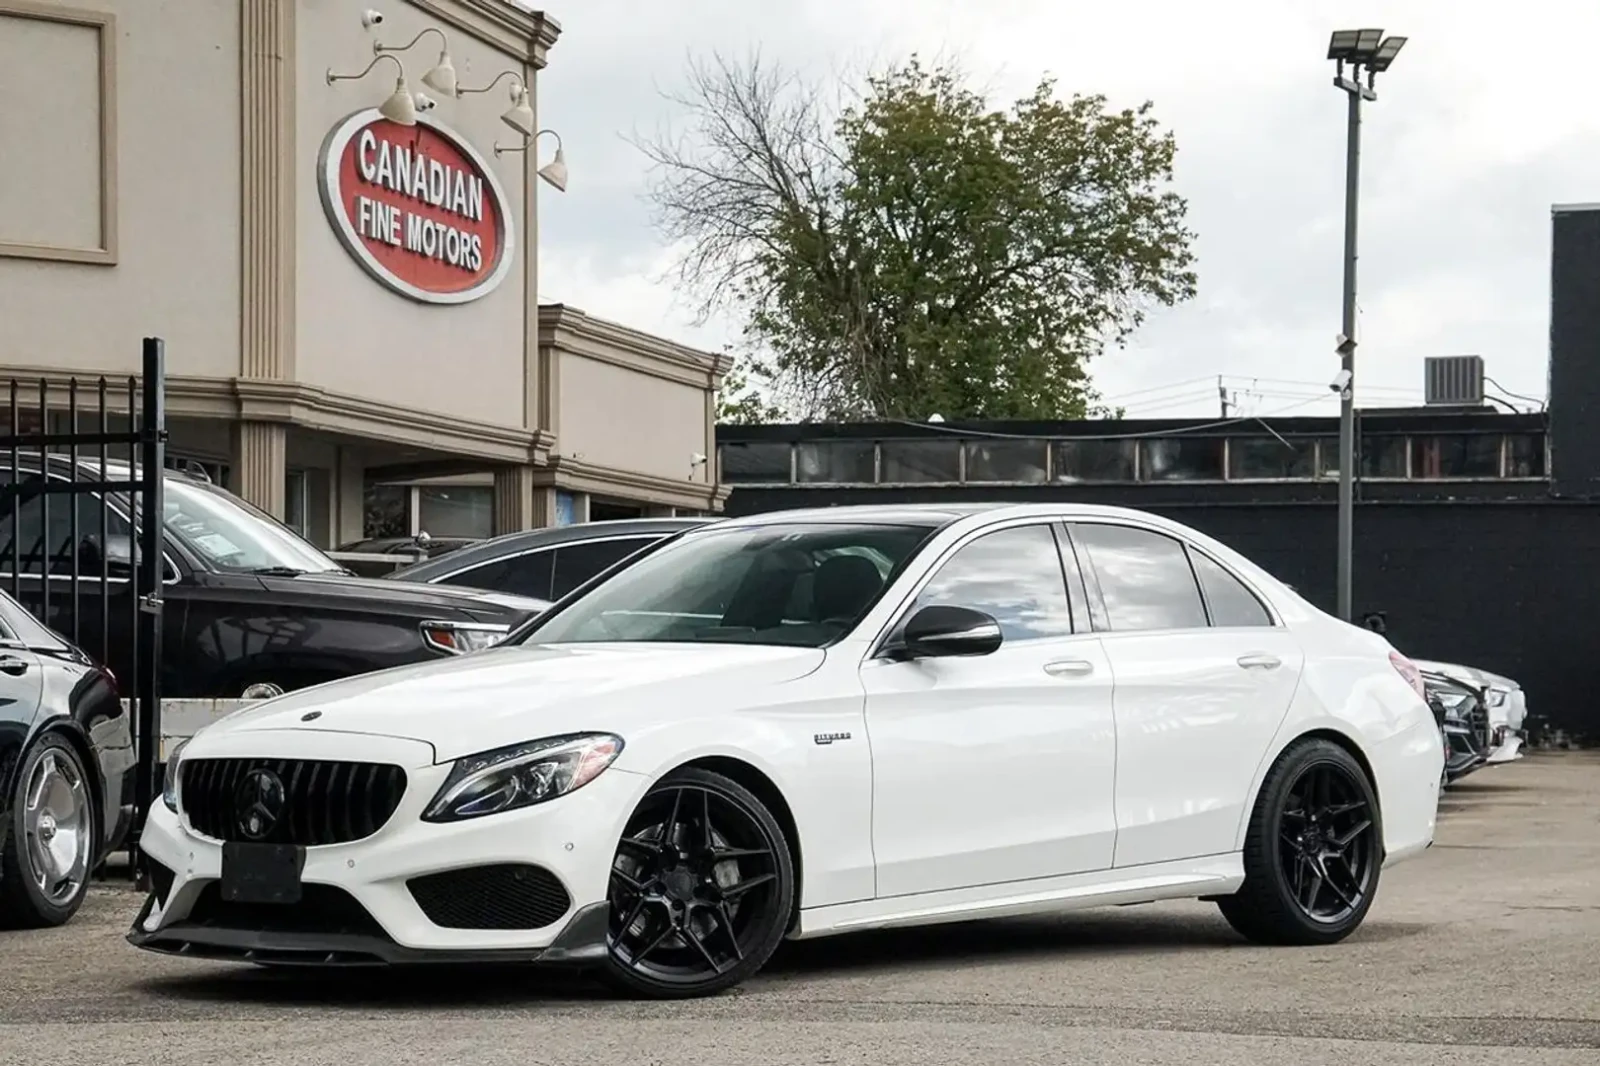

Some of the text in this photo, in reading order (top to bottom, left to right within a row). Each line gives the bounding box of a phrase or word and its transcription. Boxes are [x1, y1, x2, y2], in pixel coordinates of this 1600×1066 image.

[359, 129, 483, 221] CANADIAN
[359, 196, 482, 272] FINE MOTORS
